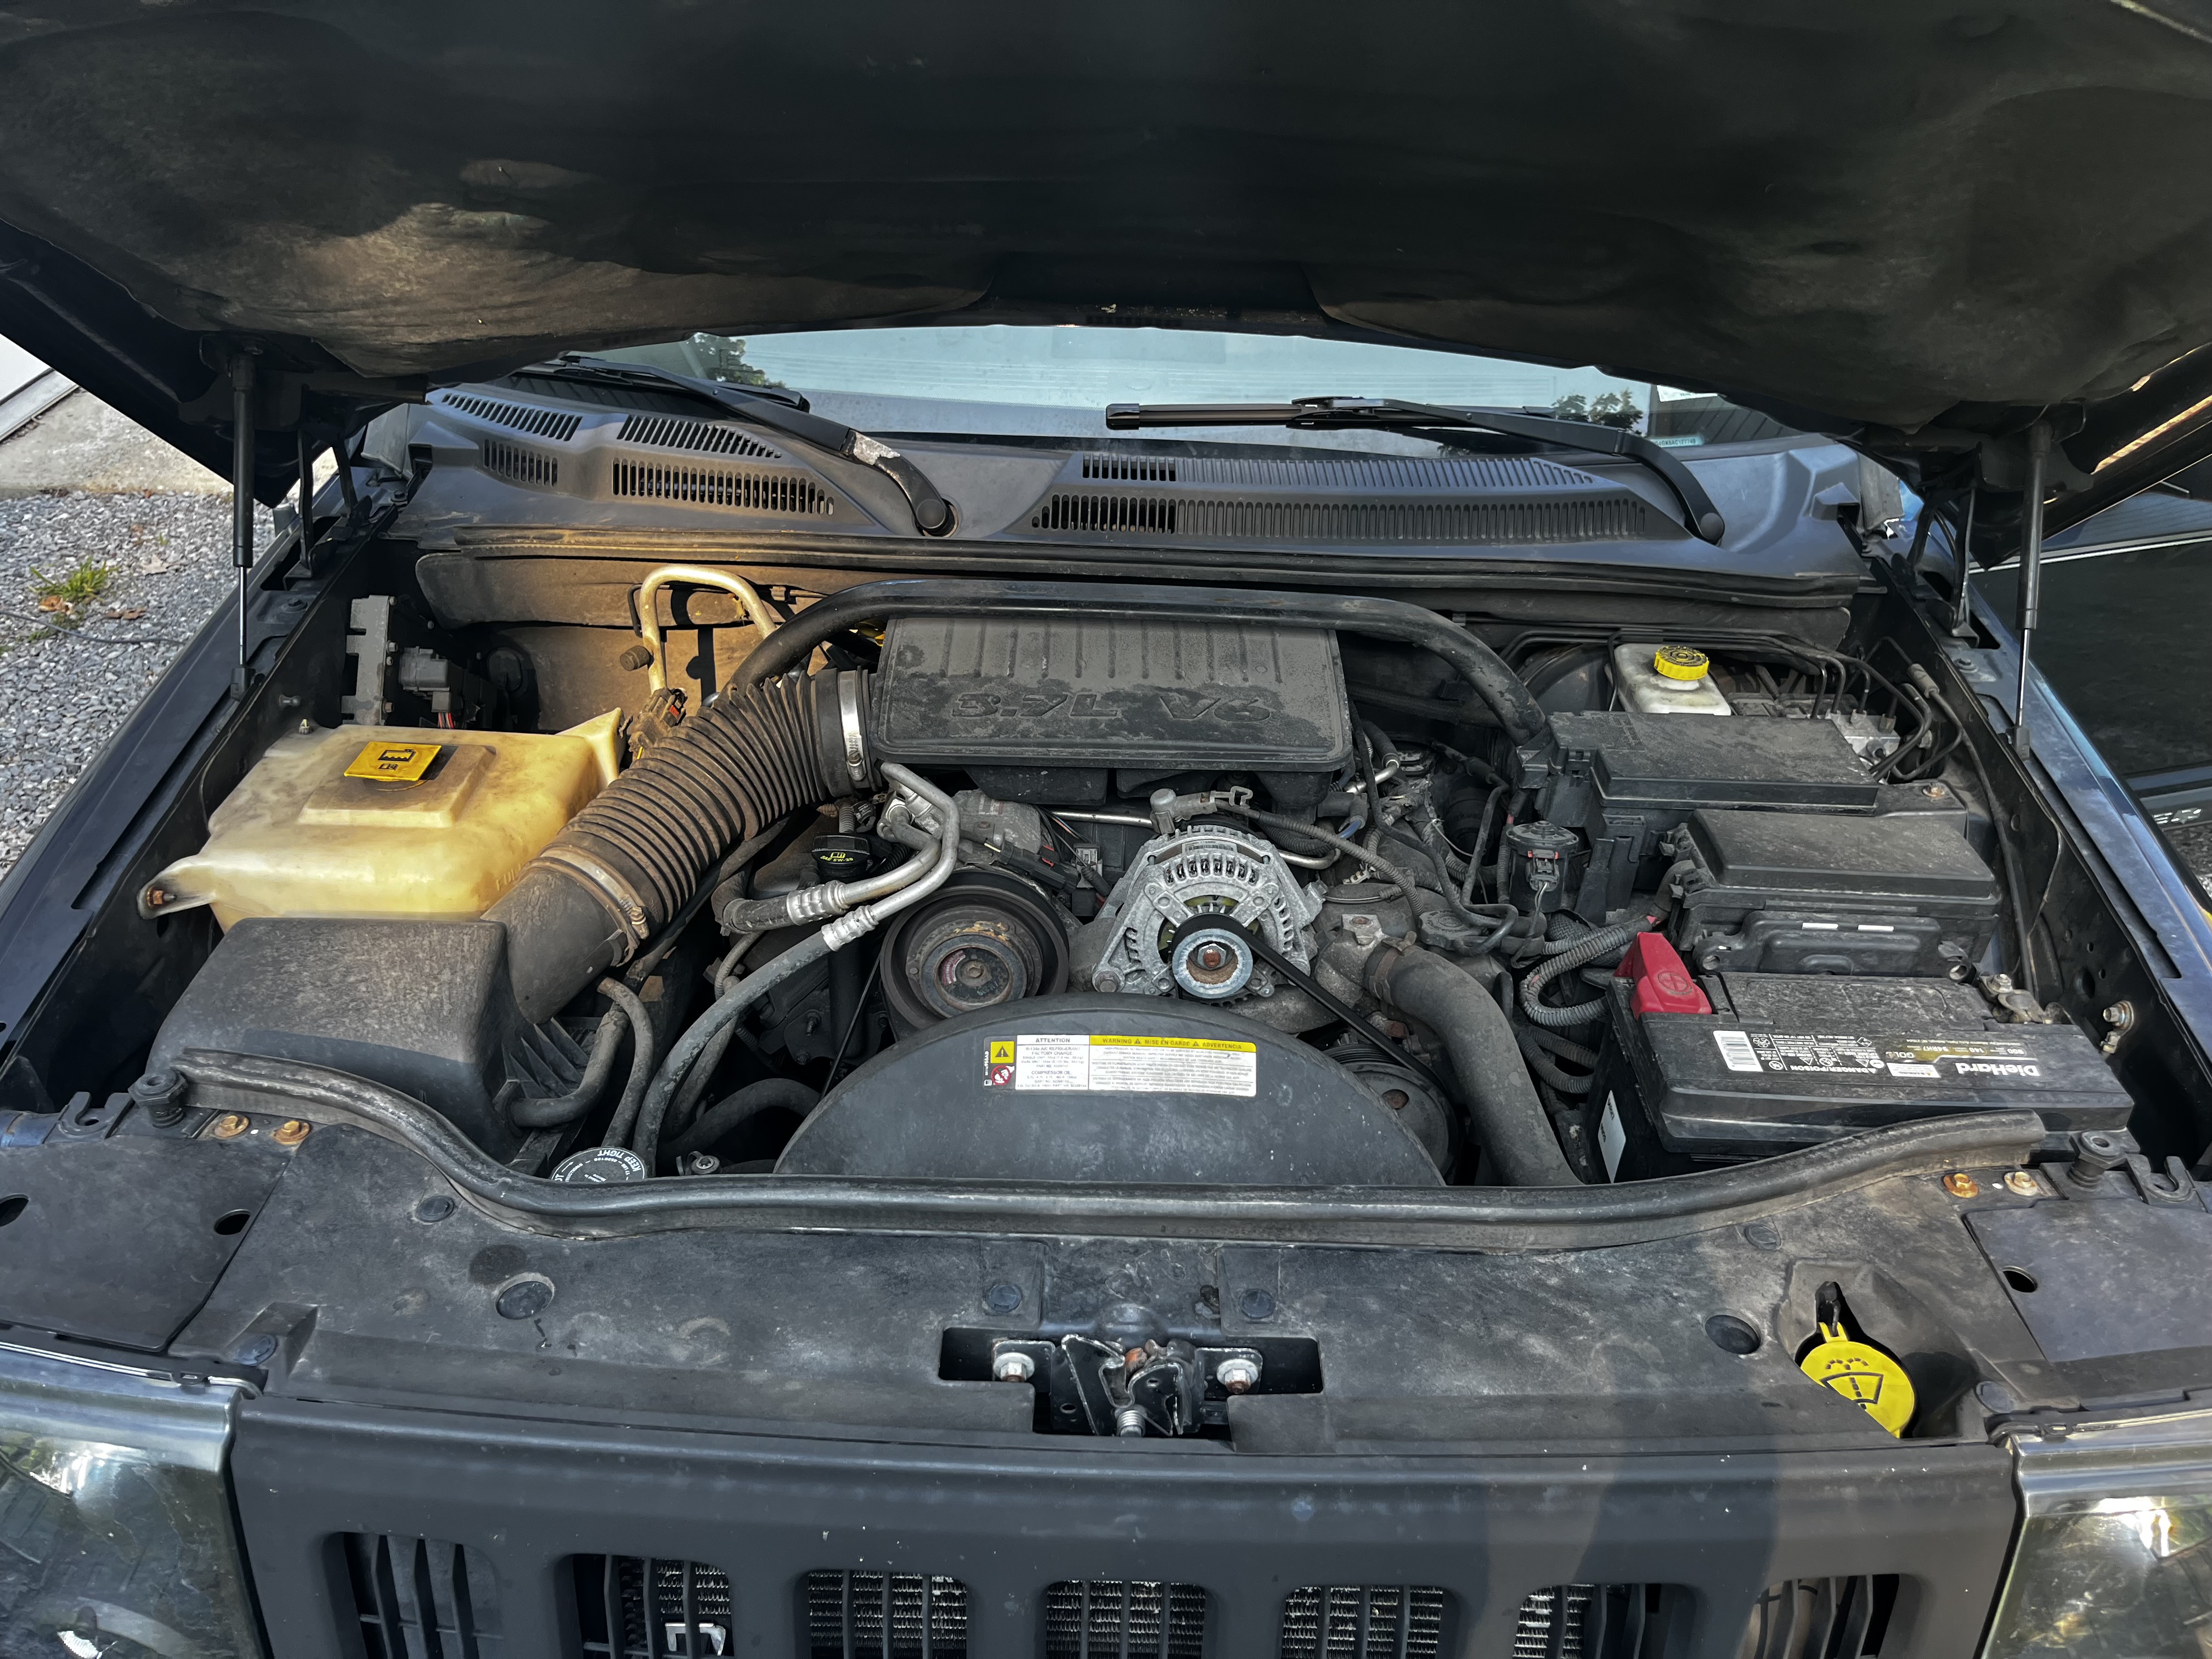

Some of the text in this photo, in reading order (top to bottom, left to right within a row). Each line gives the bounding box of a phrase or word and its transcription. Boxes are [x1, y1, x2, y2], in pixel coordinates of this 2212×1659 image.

[952, 693, 1272, 722] 3.7L V6
[1955, 1062, 2040, 1076] DieHard
[597, 1150, 641, 1172] KEEP TIGHT
